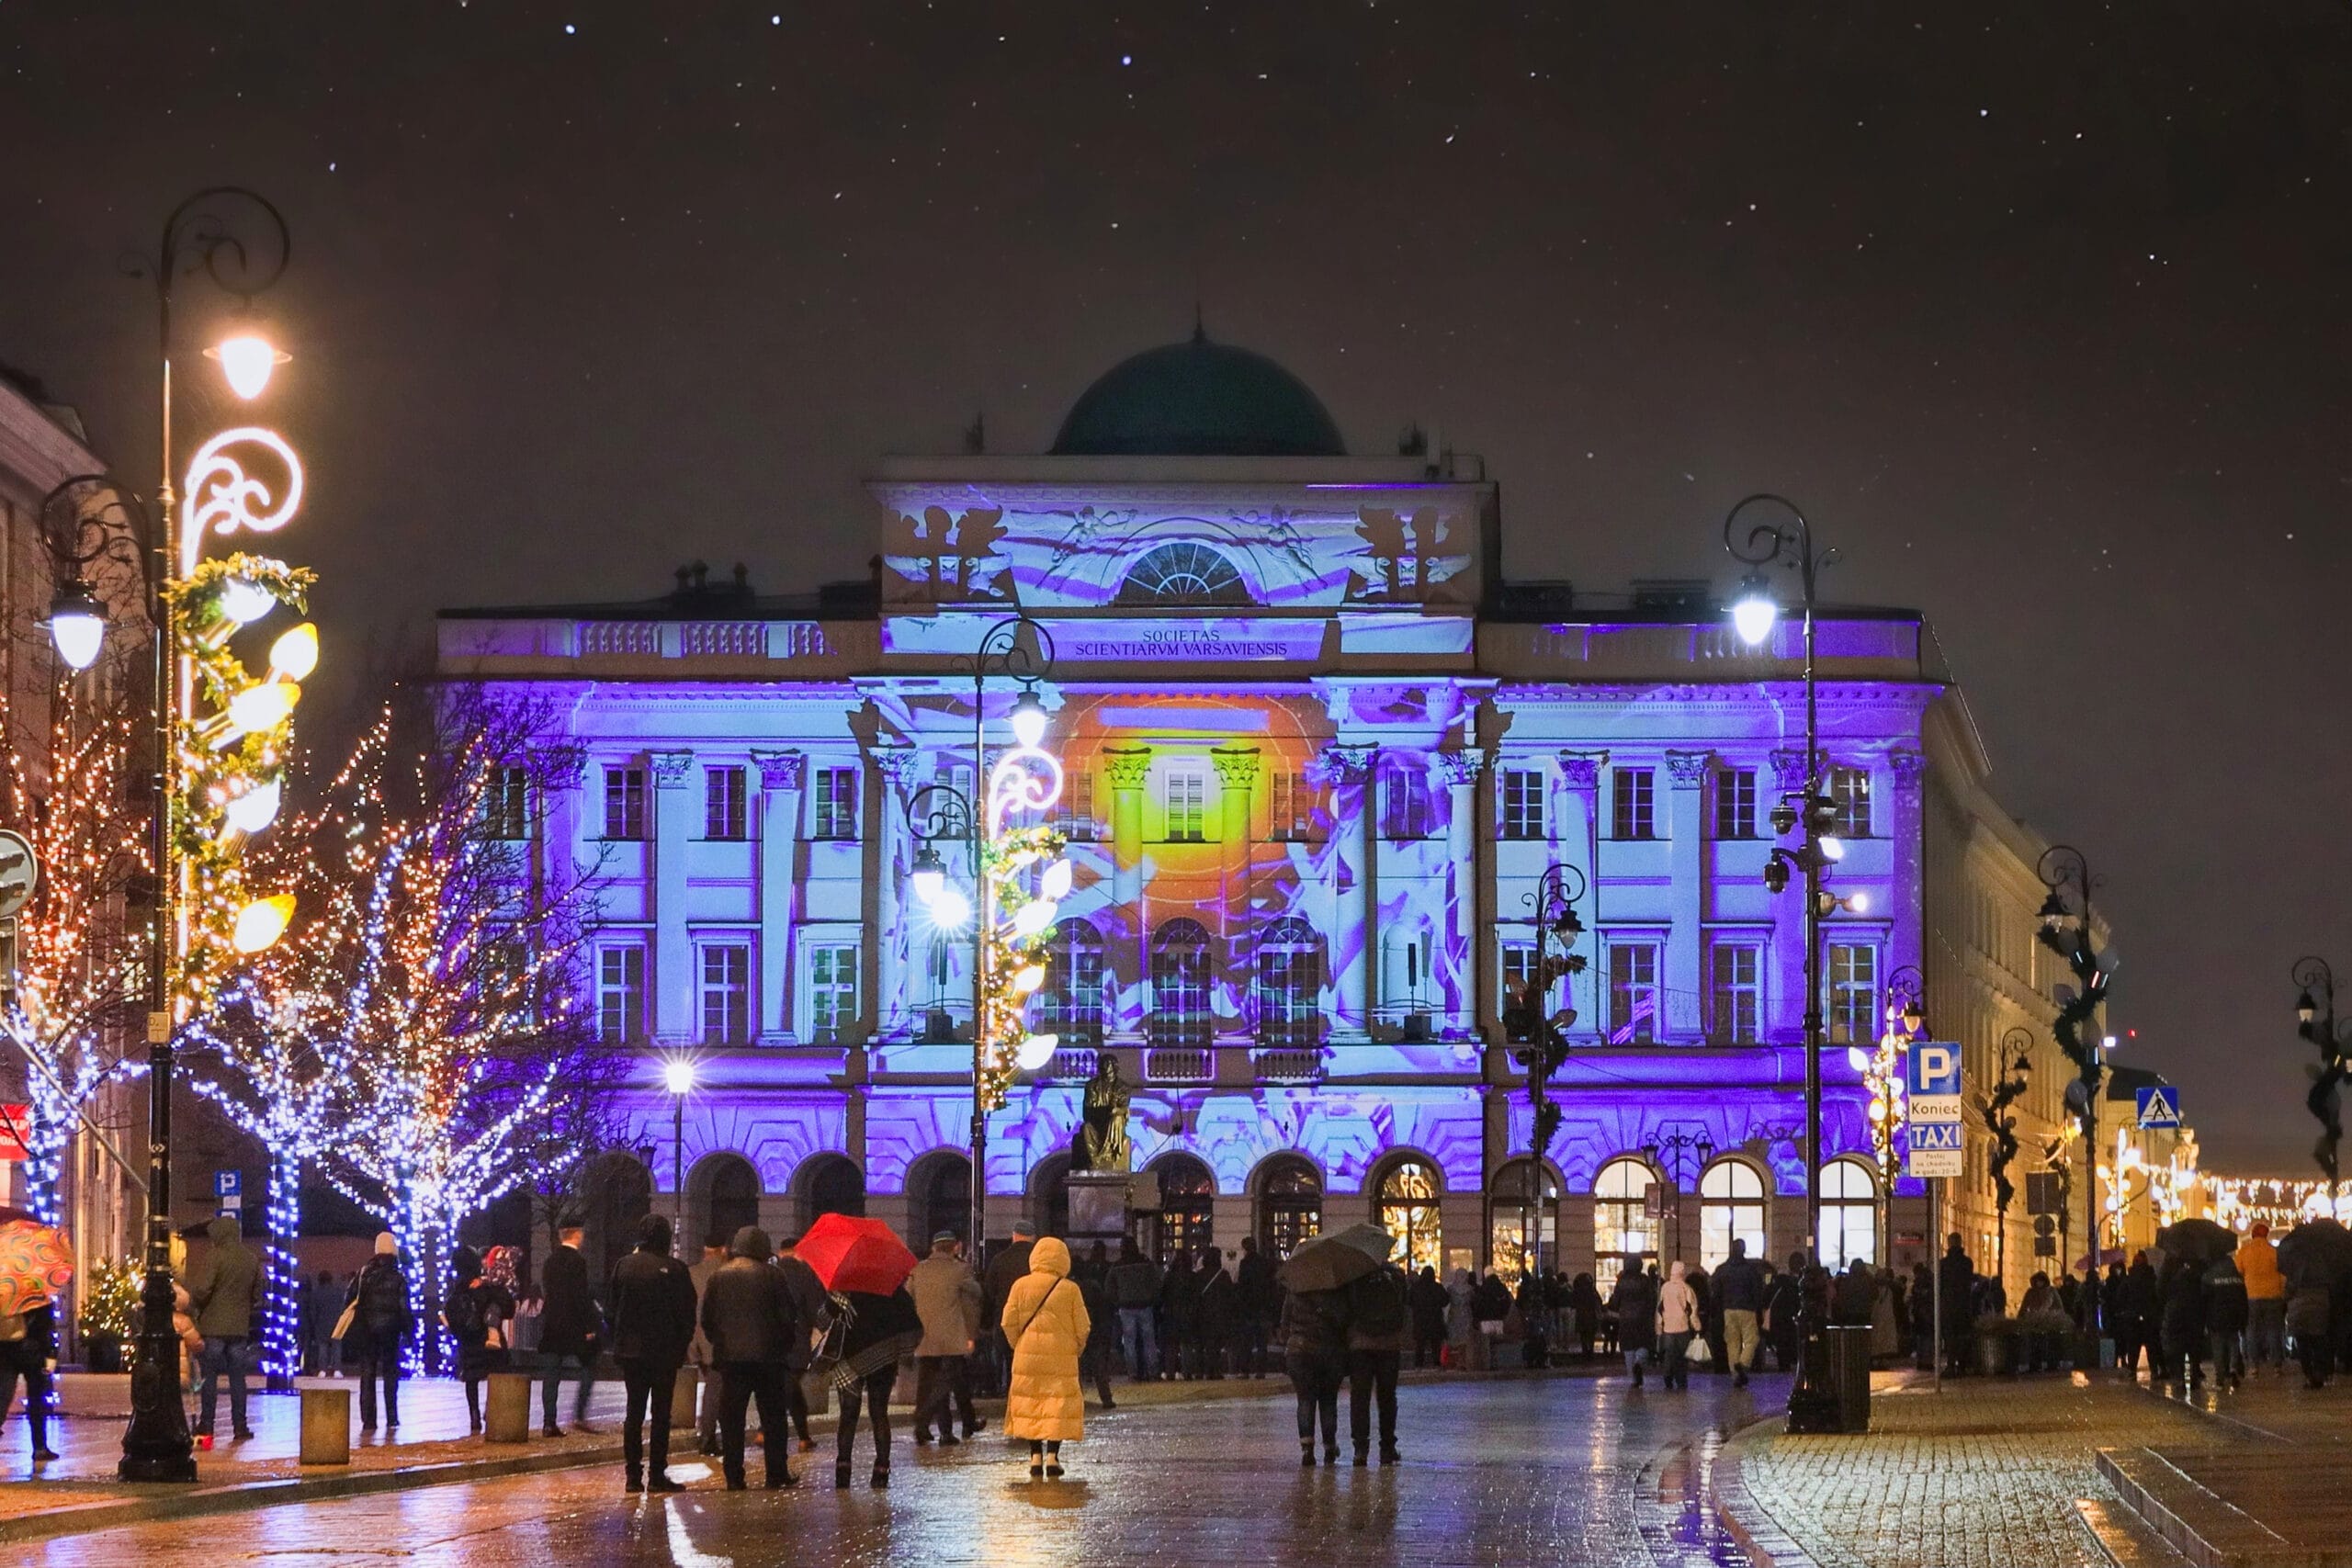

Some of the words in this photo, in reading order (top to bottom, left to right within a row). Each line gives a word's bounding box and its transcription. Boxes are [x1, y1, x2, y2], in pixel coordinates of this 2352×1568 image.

[1143, 630, 1220, 642] SOCIETAS
[1076, 643, 1179, 656] SCIENTIARVM
[1184, 643, 1287, 655] VARSAVIENSIS
[1920, 1048, 1951, 1089] P
[1911, 1102, 1959, 1115] Koniec
[1912, 1125, 1960, 1147] TAXI
[220, 1173, 236, 1194] P
